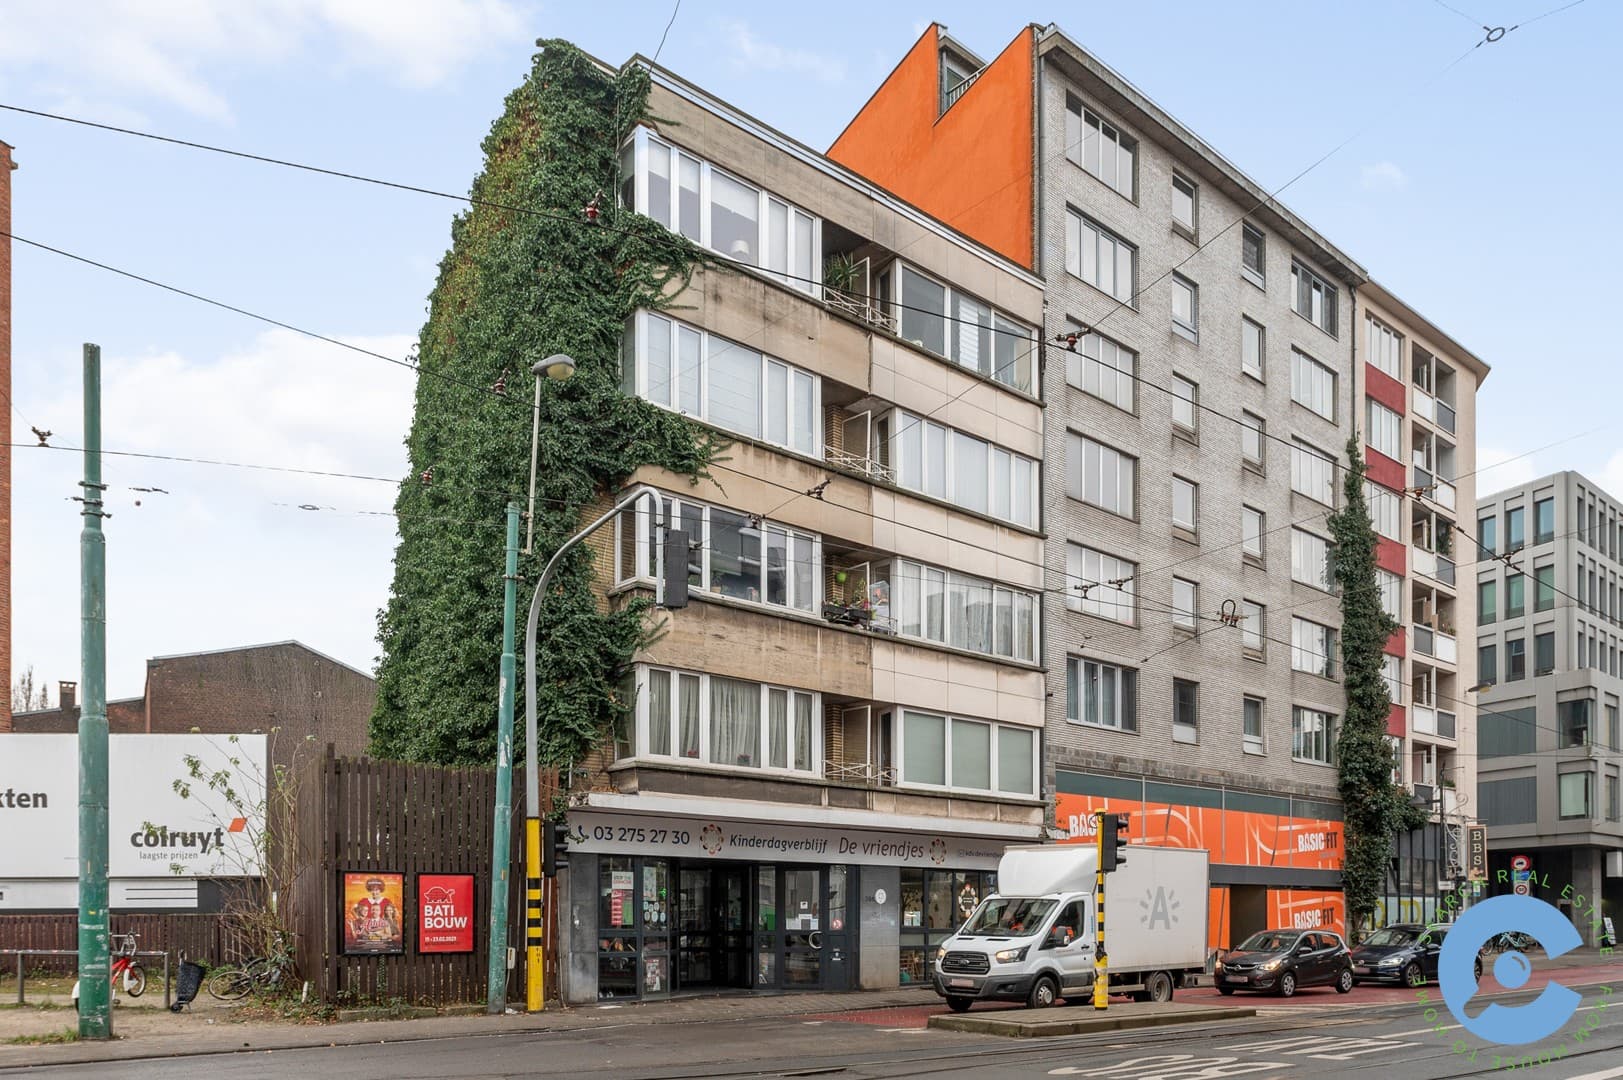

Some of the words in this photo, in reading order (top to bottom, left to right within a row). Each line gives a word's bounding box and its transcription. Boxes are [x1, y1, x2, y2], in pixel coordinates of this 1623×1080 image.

[130, 826, 225, 854] colruyt
[593, 826, 613, 841] 03
[618, 827, 646, 843] 275
[650, 829, 667, 844] 27
[671, 830, 690, 845] 30
[729, 834, 828, 854] Kinderdagverblijf
[838, 836, 858, 855] De
[862, 839, 924, 861] vriendjes
[139, 851, 168, 861] laagste
[170, 851, 198, 861] prijzen
[424, 905, 454, 916] BATI
[424, 917, 467, 929] BOUW
